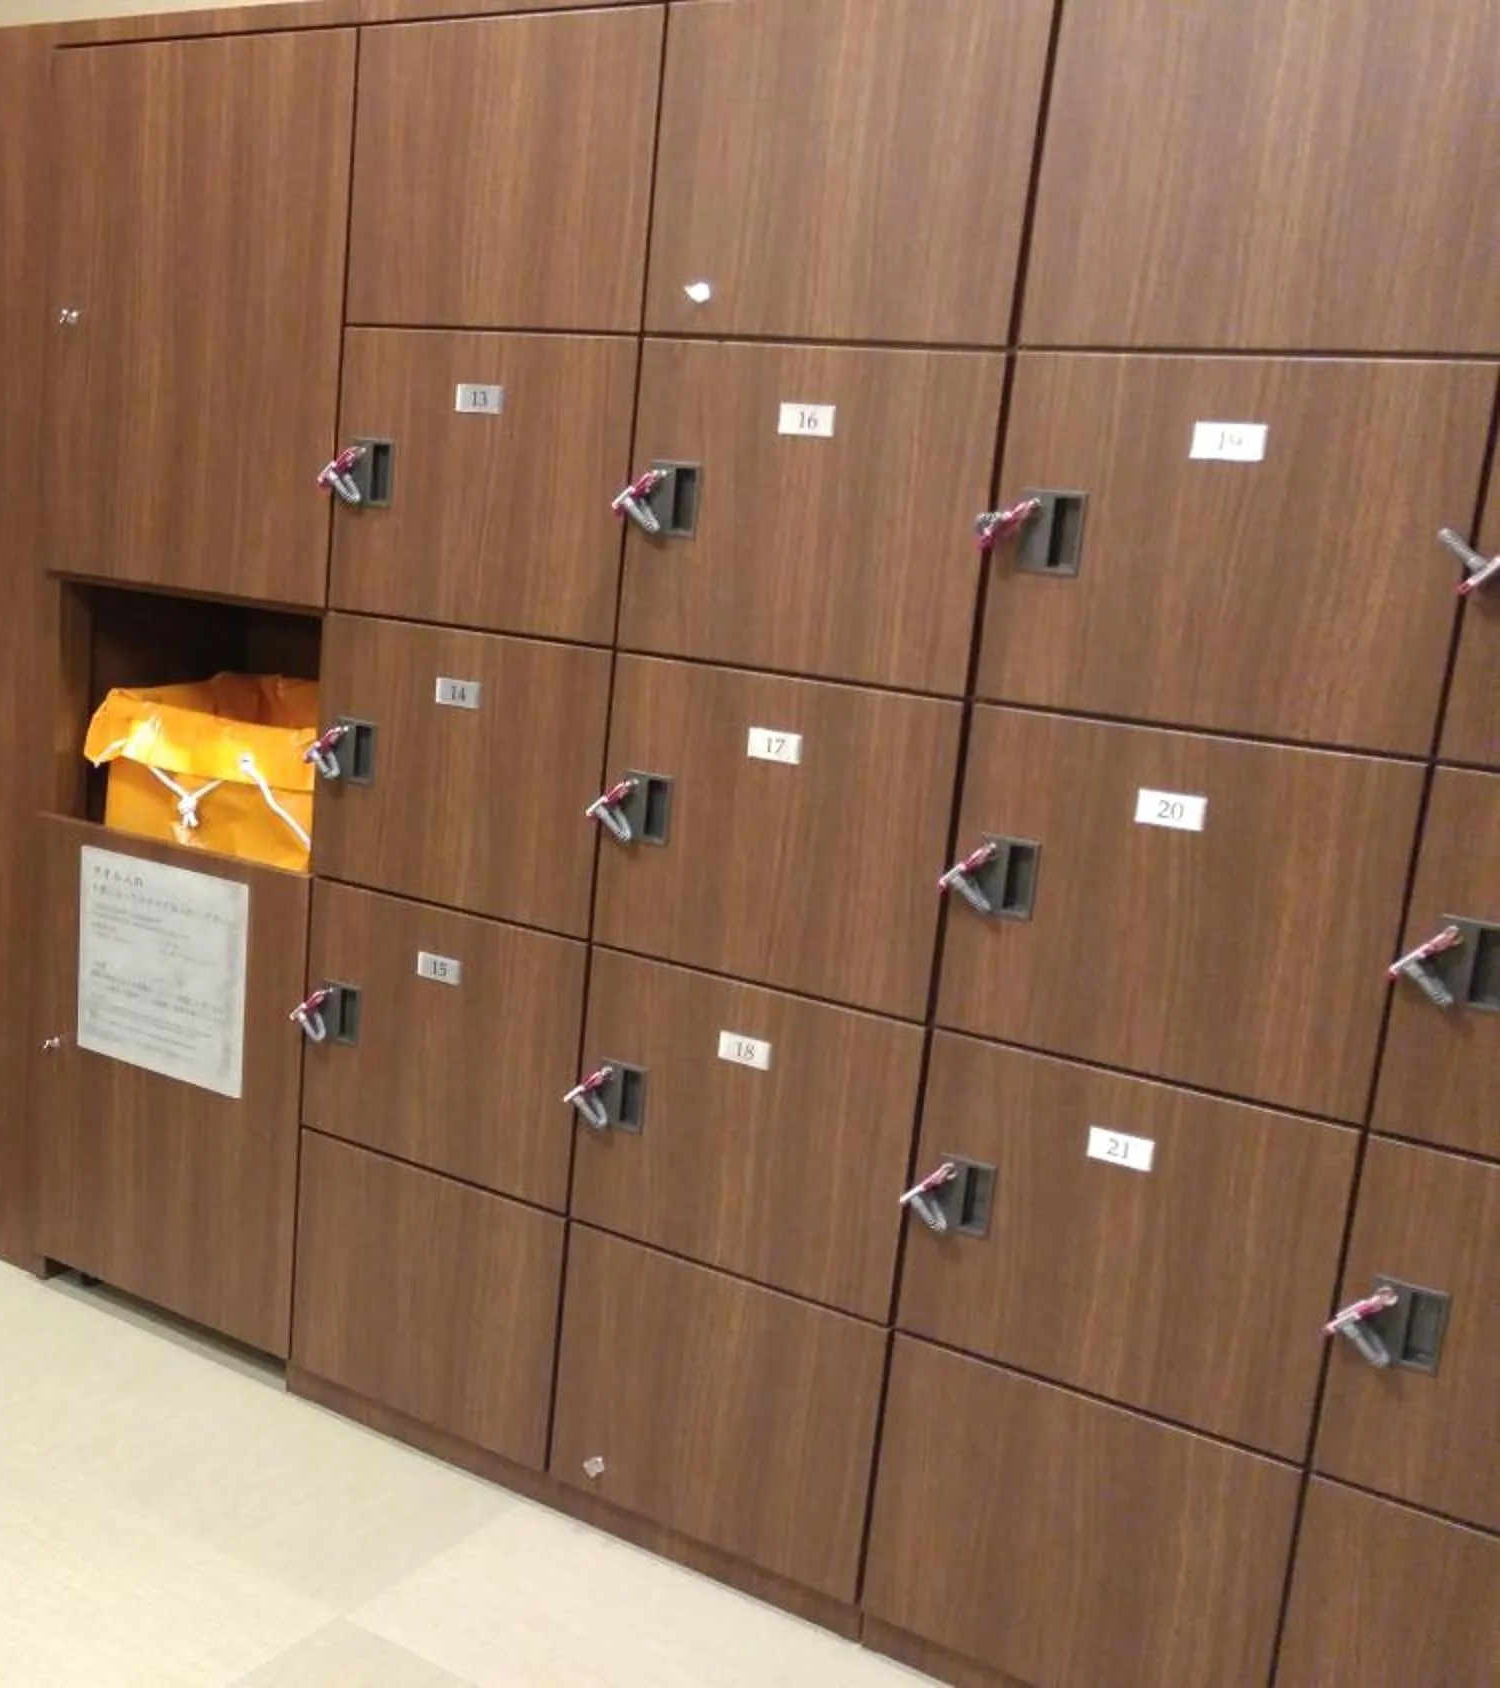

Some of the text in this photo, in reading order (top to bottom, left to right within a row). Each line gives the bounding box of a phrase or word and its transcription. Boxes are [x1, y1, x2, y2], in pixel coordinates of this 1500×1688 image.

[471, 391, 487, 405] 13
[799, 412, 817, 429] 16
[451, 686, 466, 701] 14
[766, 738, 785, 754] 17
[1158, 800, 1184, 820] 20
[431, 960, 447, 975] 15
[736, 1042, 754, 1060] 18
[1107, 1138, 1129, 1158] 21
